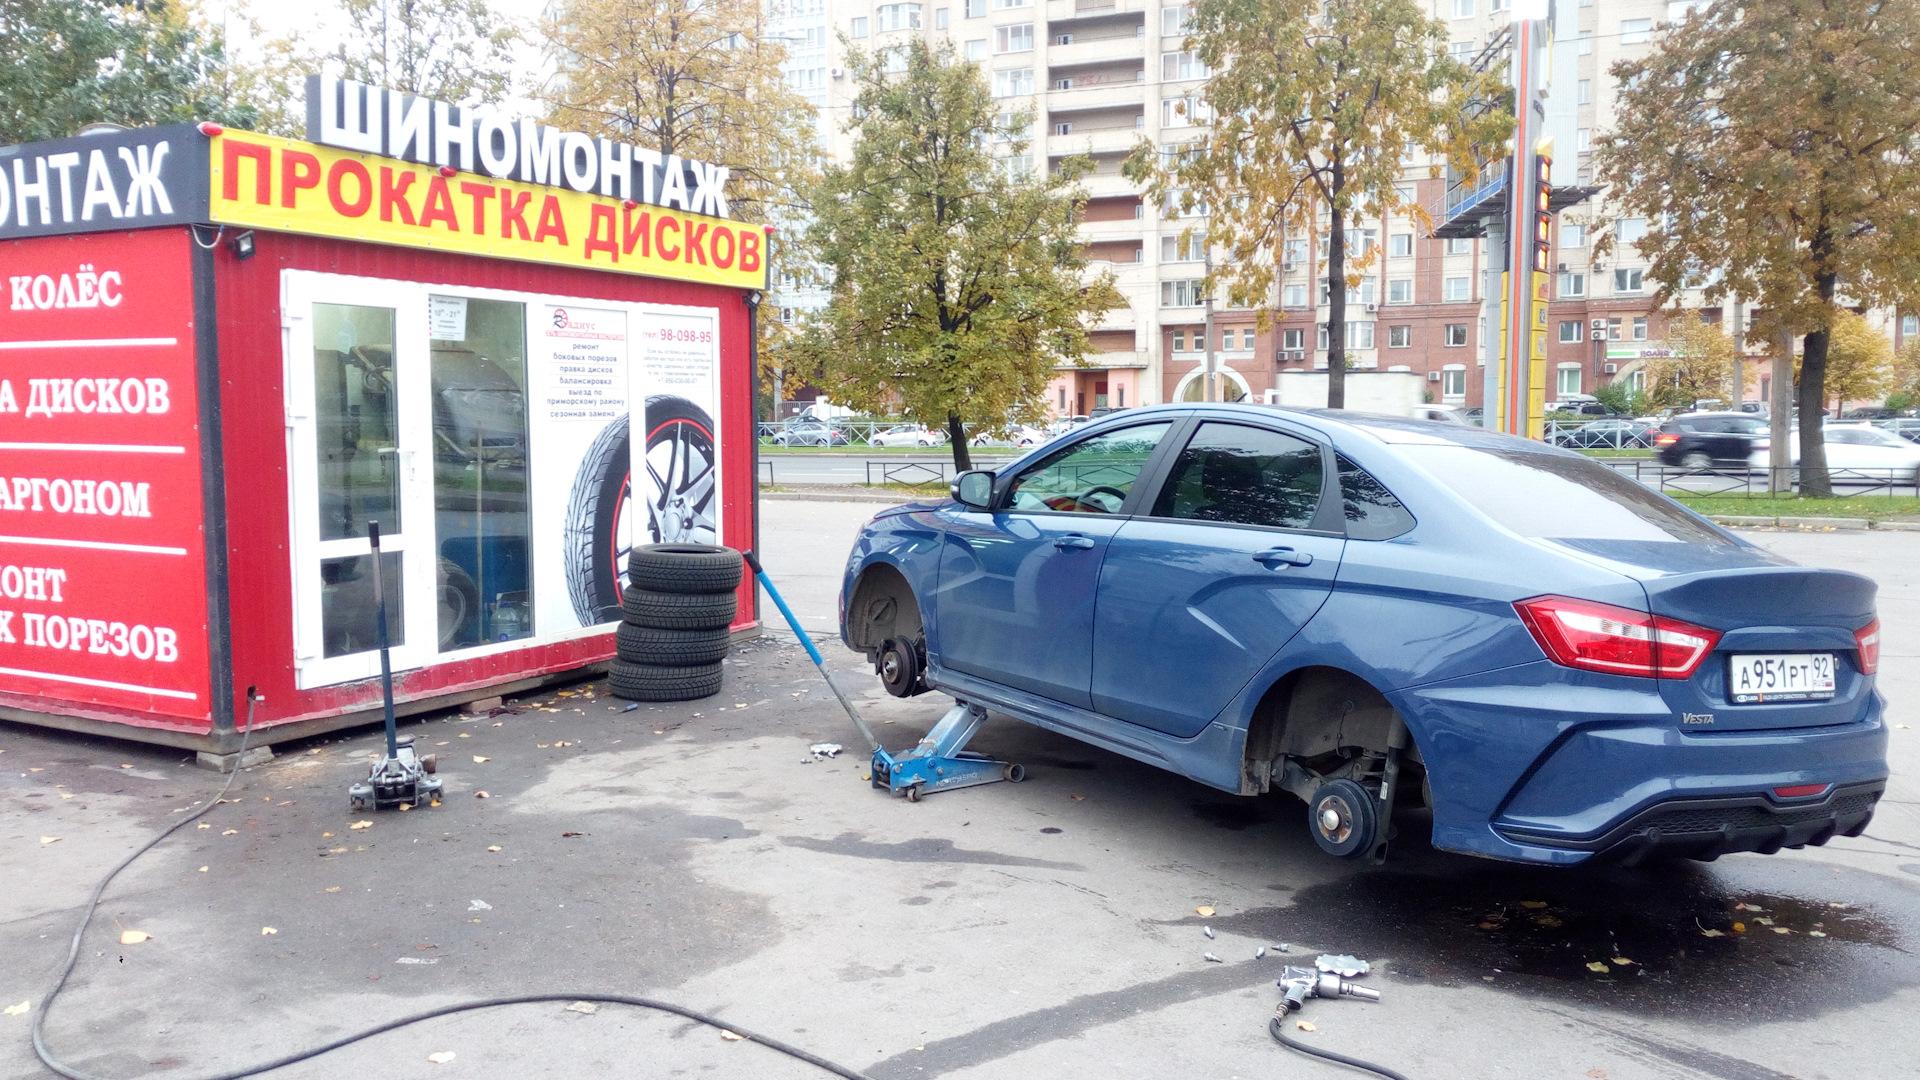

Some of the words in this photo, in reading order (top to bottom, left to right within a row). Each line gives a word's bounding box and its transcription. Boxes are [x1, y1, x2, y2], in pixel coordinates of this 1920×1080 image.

[320, 77, 730, 219] ШИНОМОНТАЖ
[0, 141, 174, 227] НТАЖ
[222, 138, 568, 247] ПРОКАТКА
[584, 203, 761, 273] ДИСКОВ
[9, 264, 123, 310] КОЛЁС
[572, 343, 599, 351] ремонт
[660, 328, 711, 343] 98-098-95
[553, 352, 586, 361] боковых
[25, 377, 170, 418] ДИСКОВ
[559, 376, 612, 386] балансировка
[547, 398, 597, 407] приморскому
[0, 565, 67, 603] ОНТ
[22, 612, 178, 662] ПОРЕЗОВ
